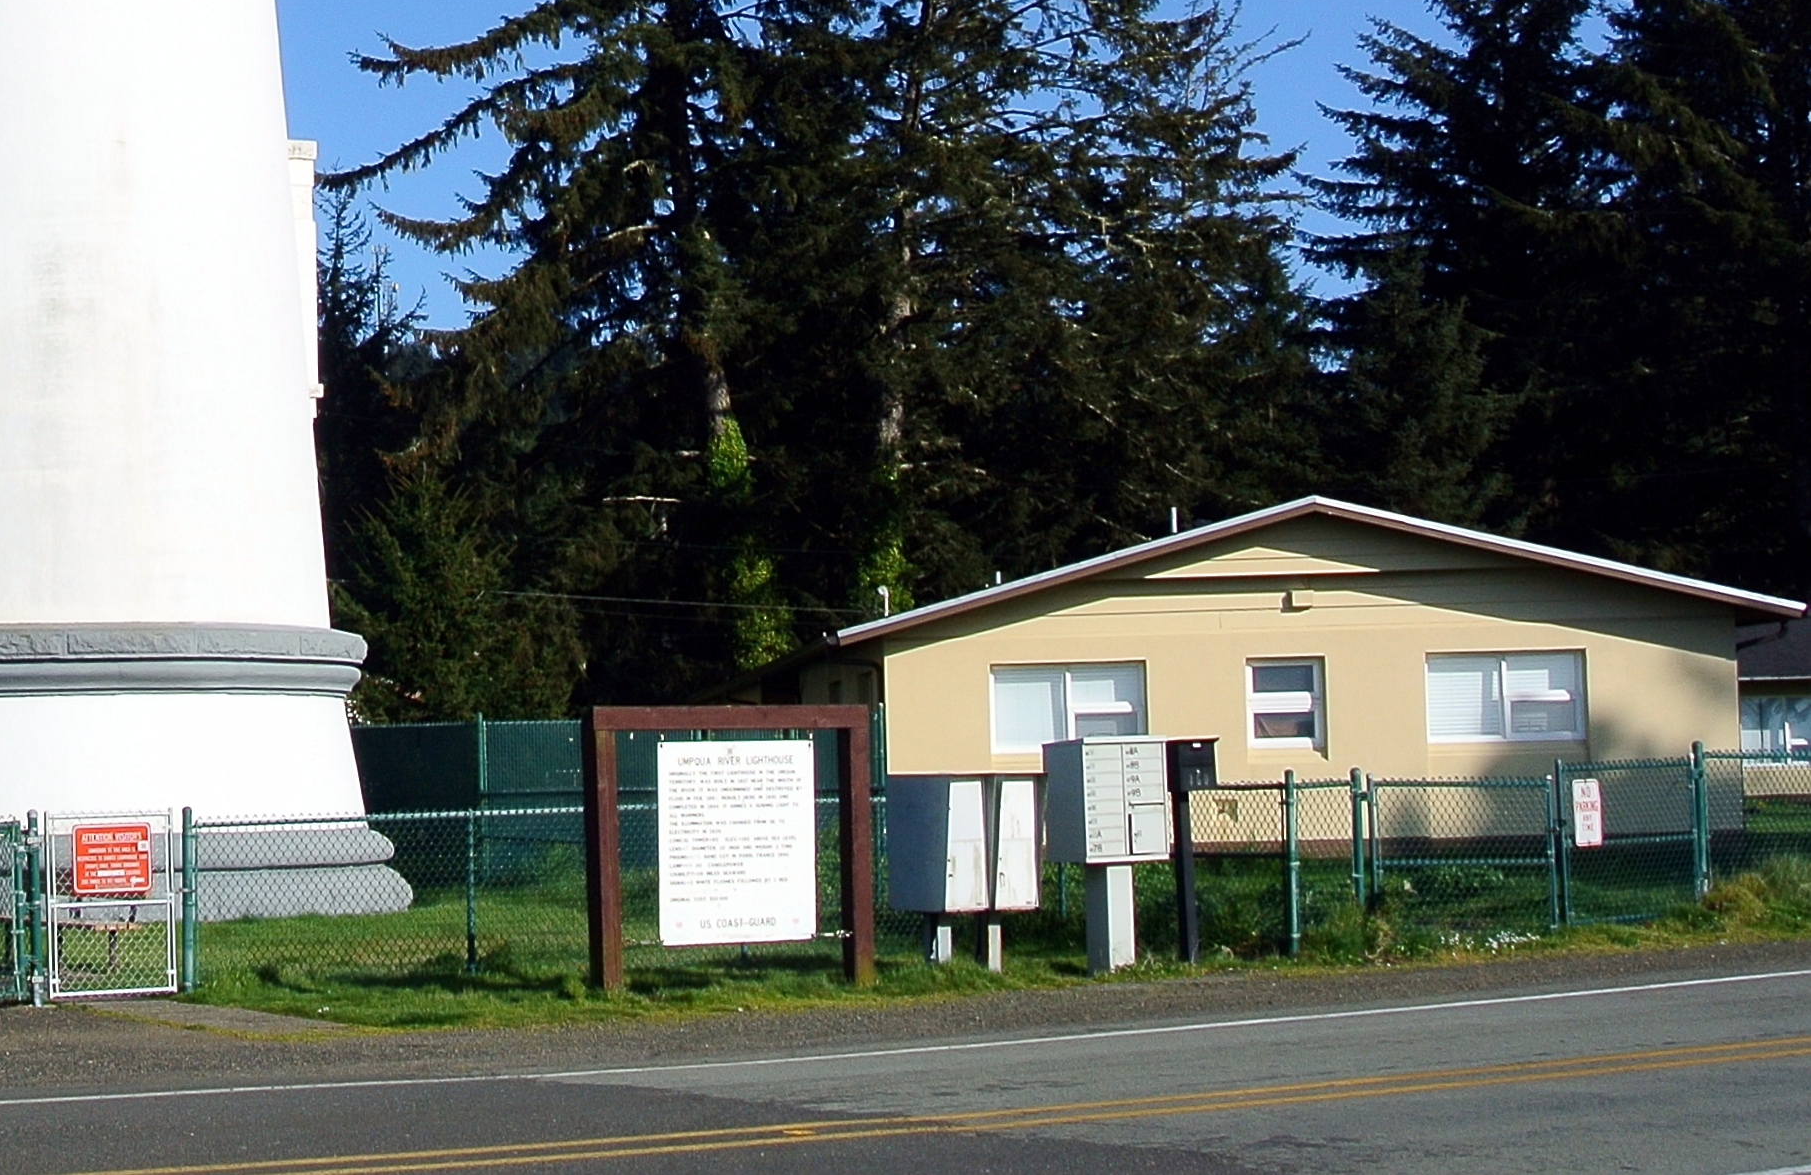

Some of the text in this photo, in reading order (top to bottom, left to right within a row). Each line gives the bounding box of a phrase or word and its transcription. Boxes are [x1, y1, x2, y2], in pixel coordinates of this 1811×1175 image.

[678, 755, 794, 766] UMPQUA RIVER LIGHTHOUSE
[700, 916, 777, 929] US COAST GUARD
